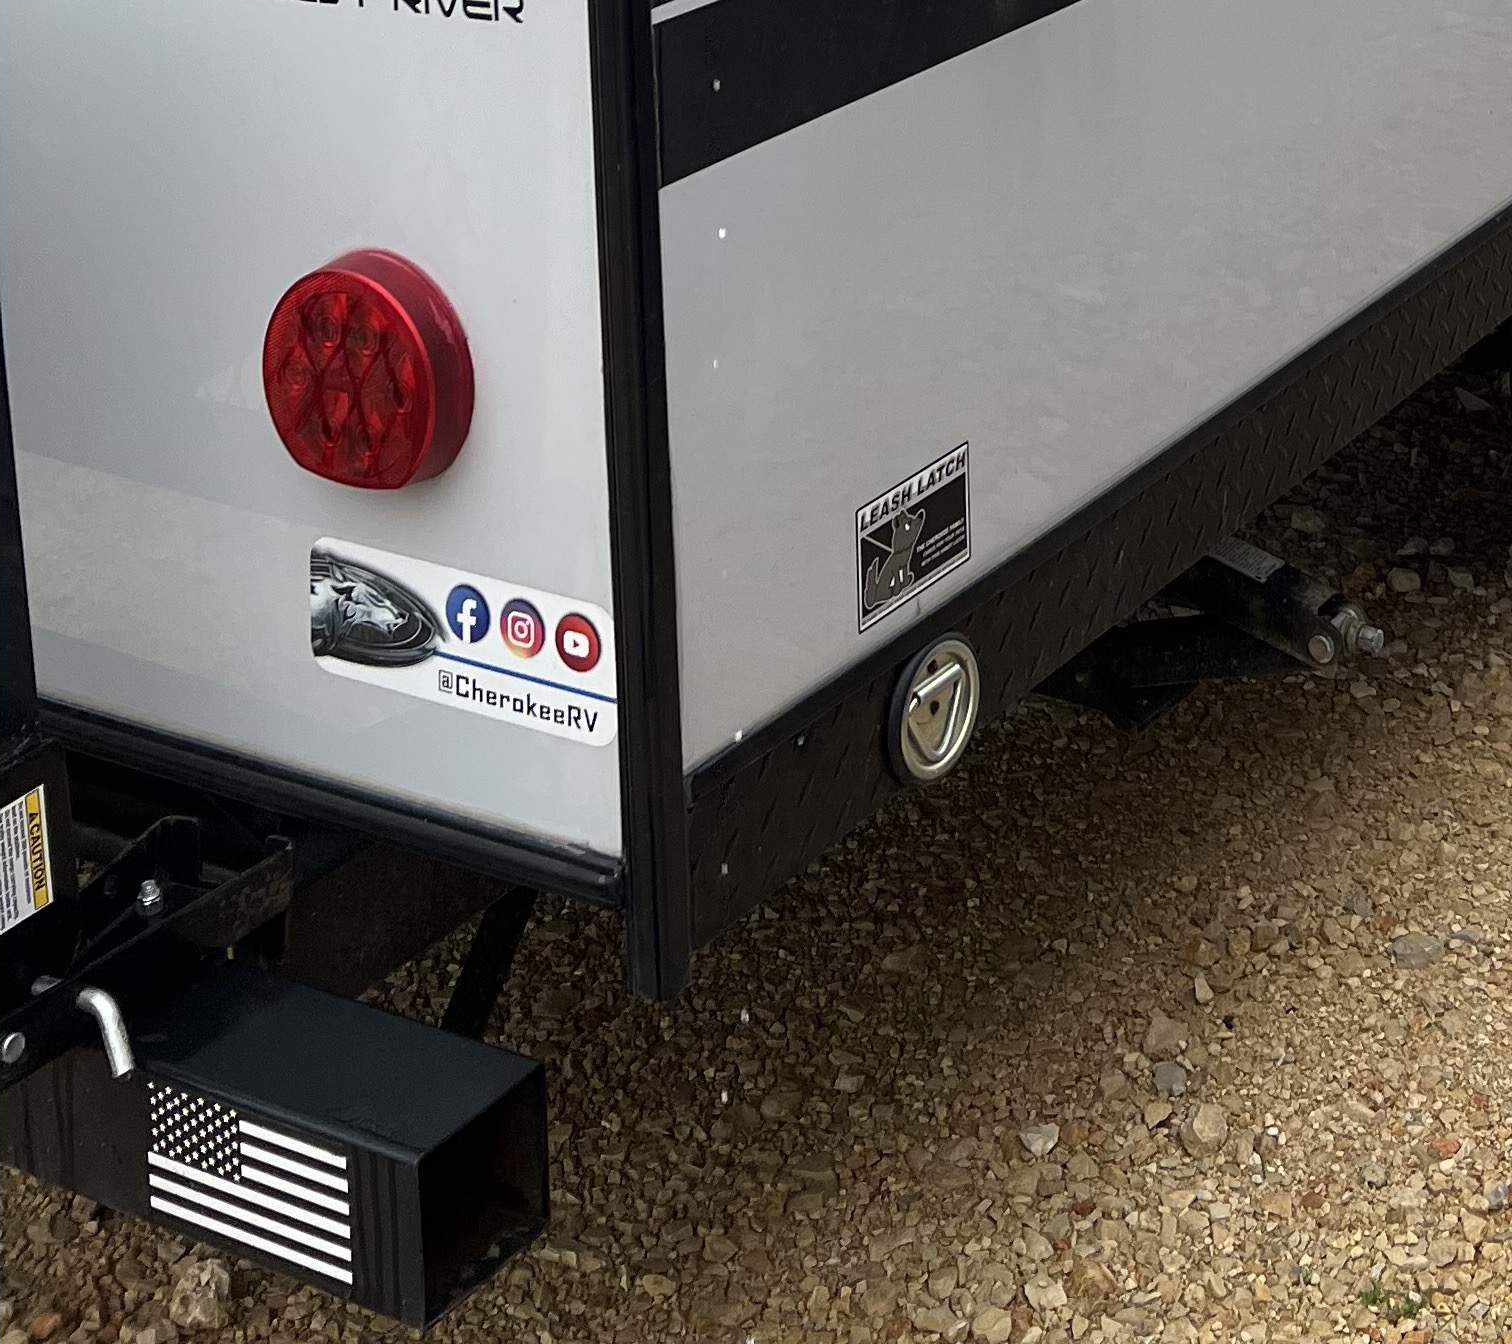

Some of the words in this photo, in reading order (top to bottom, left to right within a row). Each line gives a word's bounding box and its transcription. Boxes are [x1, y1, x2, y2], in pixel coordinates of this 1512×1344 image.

[859, 484, 913, 531] LEASH
[917, 450, 966, 497] LATCH
[438, 669, 599, 733] @CherokeeRV
[29, 823, 46, 892] CAUTION
